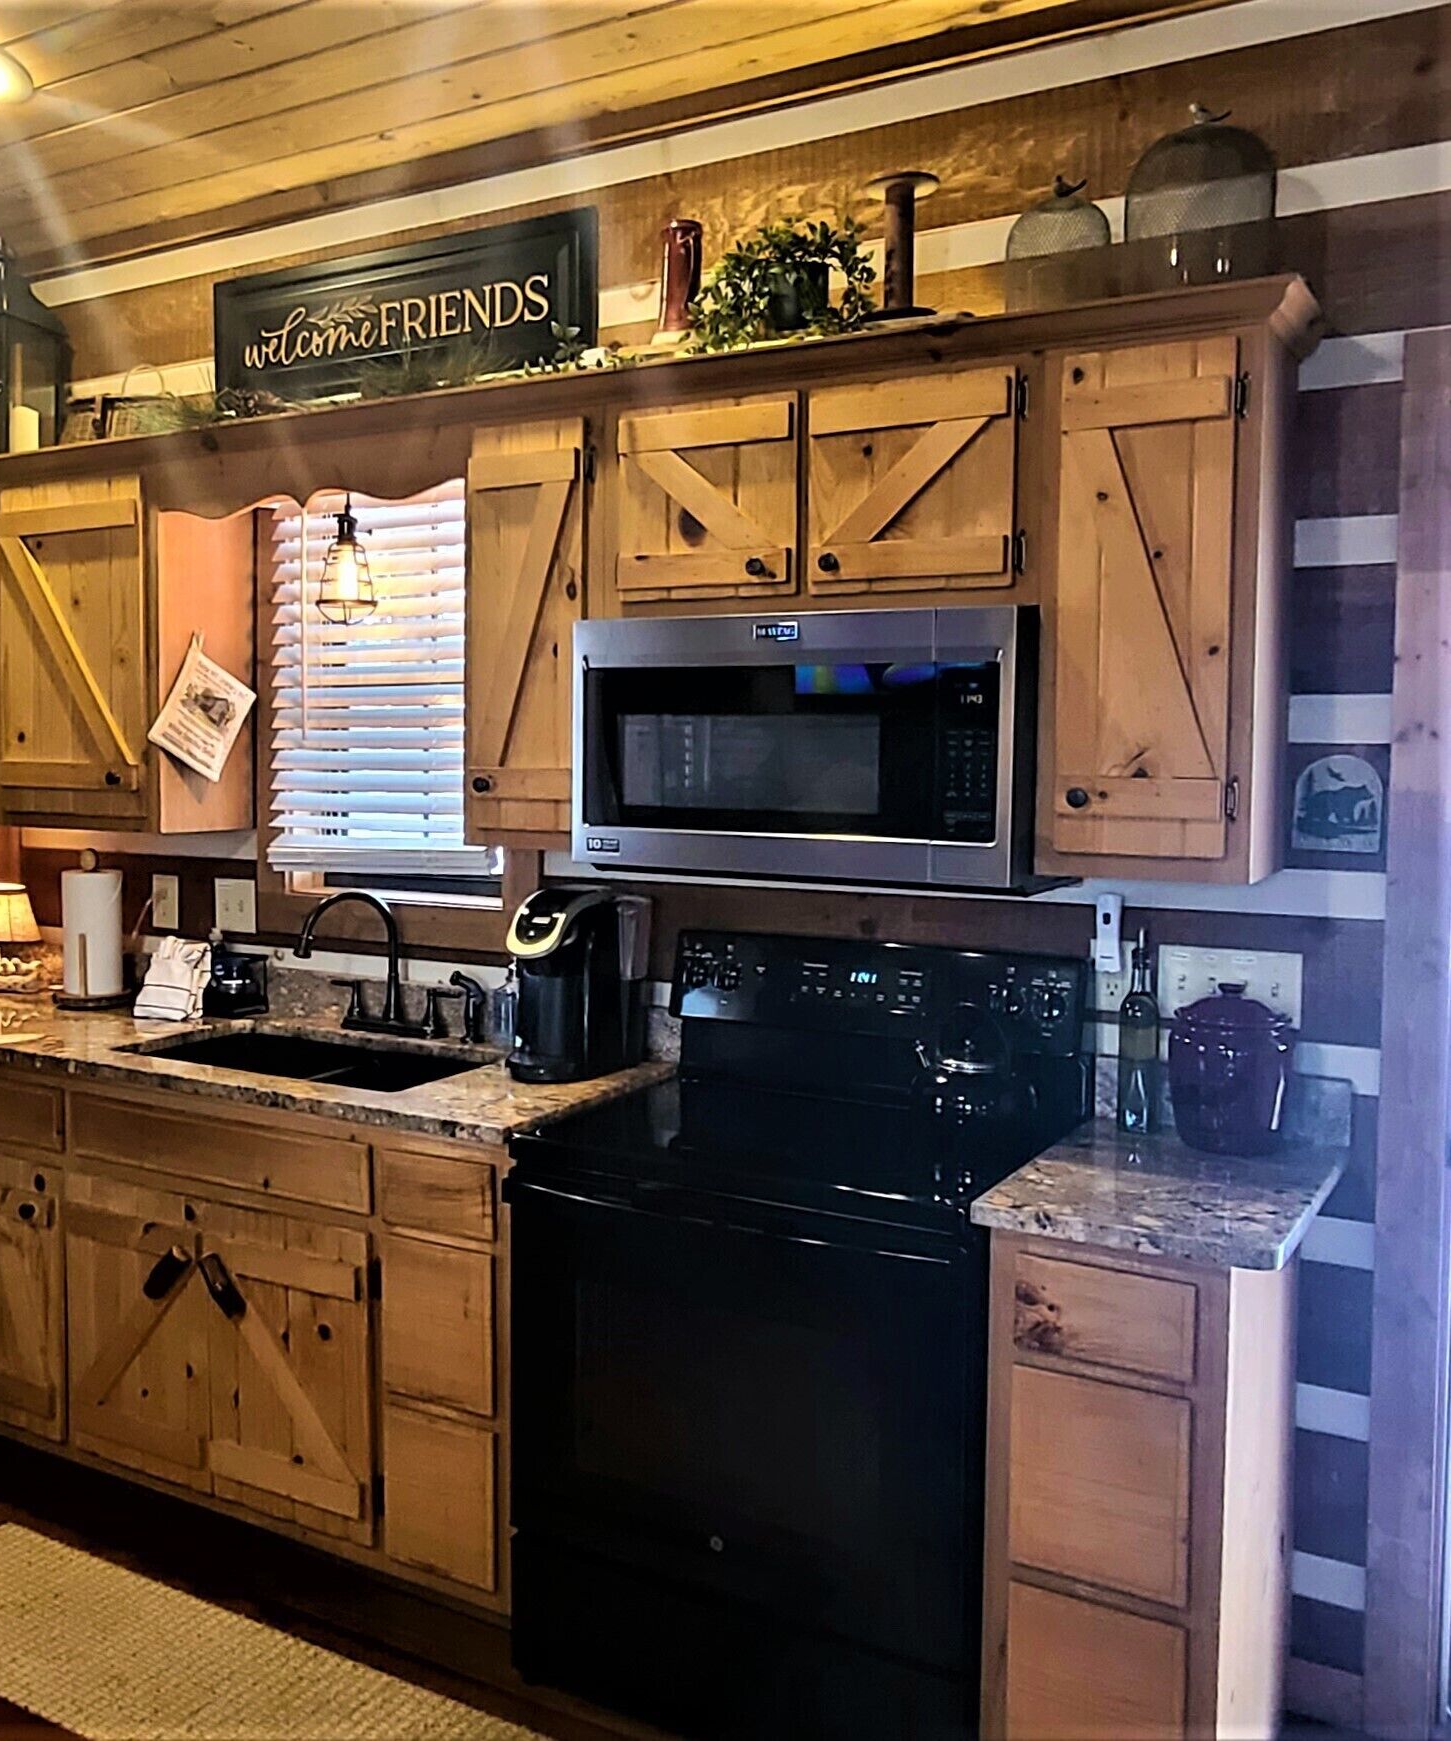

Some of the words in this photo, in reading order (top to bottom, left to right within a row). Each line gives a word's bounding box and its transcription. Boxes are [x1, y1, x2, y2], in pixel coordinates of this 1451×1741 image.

[244, 306, 380, 370] welcome
[378, 274, 550, 347] FRIENDS
[588, 838, 602, 850] 10
